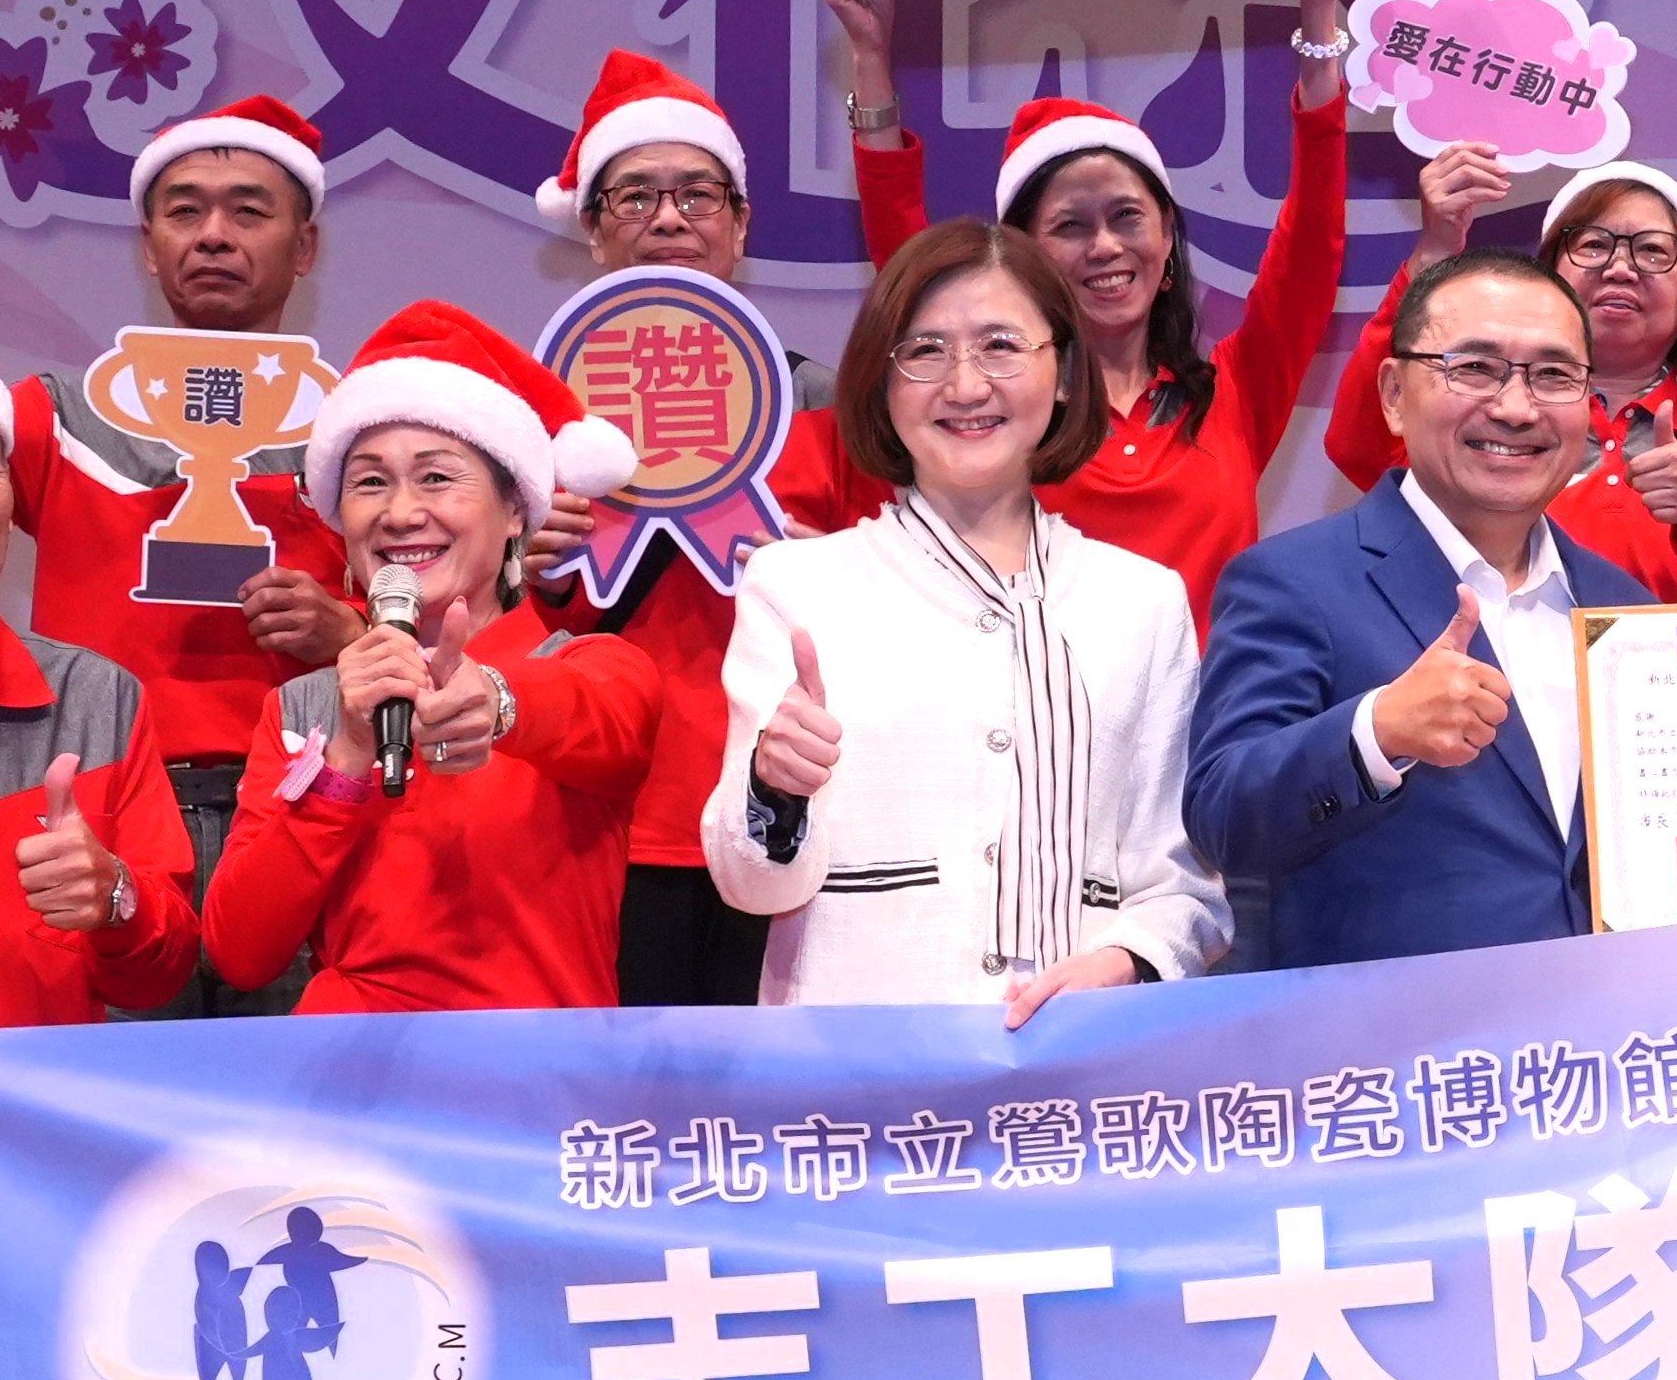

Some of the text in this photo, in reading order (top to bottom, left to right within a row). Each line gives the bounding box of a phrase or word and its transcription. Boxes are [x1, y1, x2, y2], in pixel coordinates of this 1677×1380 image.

[1383, 21, 1597, 116] 愛在行動中
[184, 366, 244, 427] 讚
[582, 322, 734, 469] 讚
